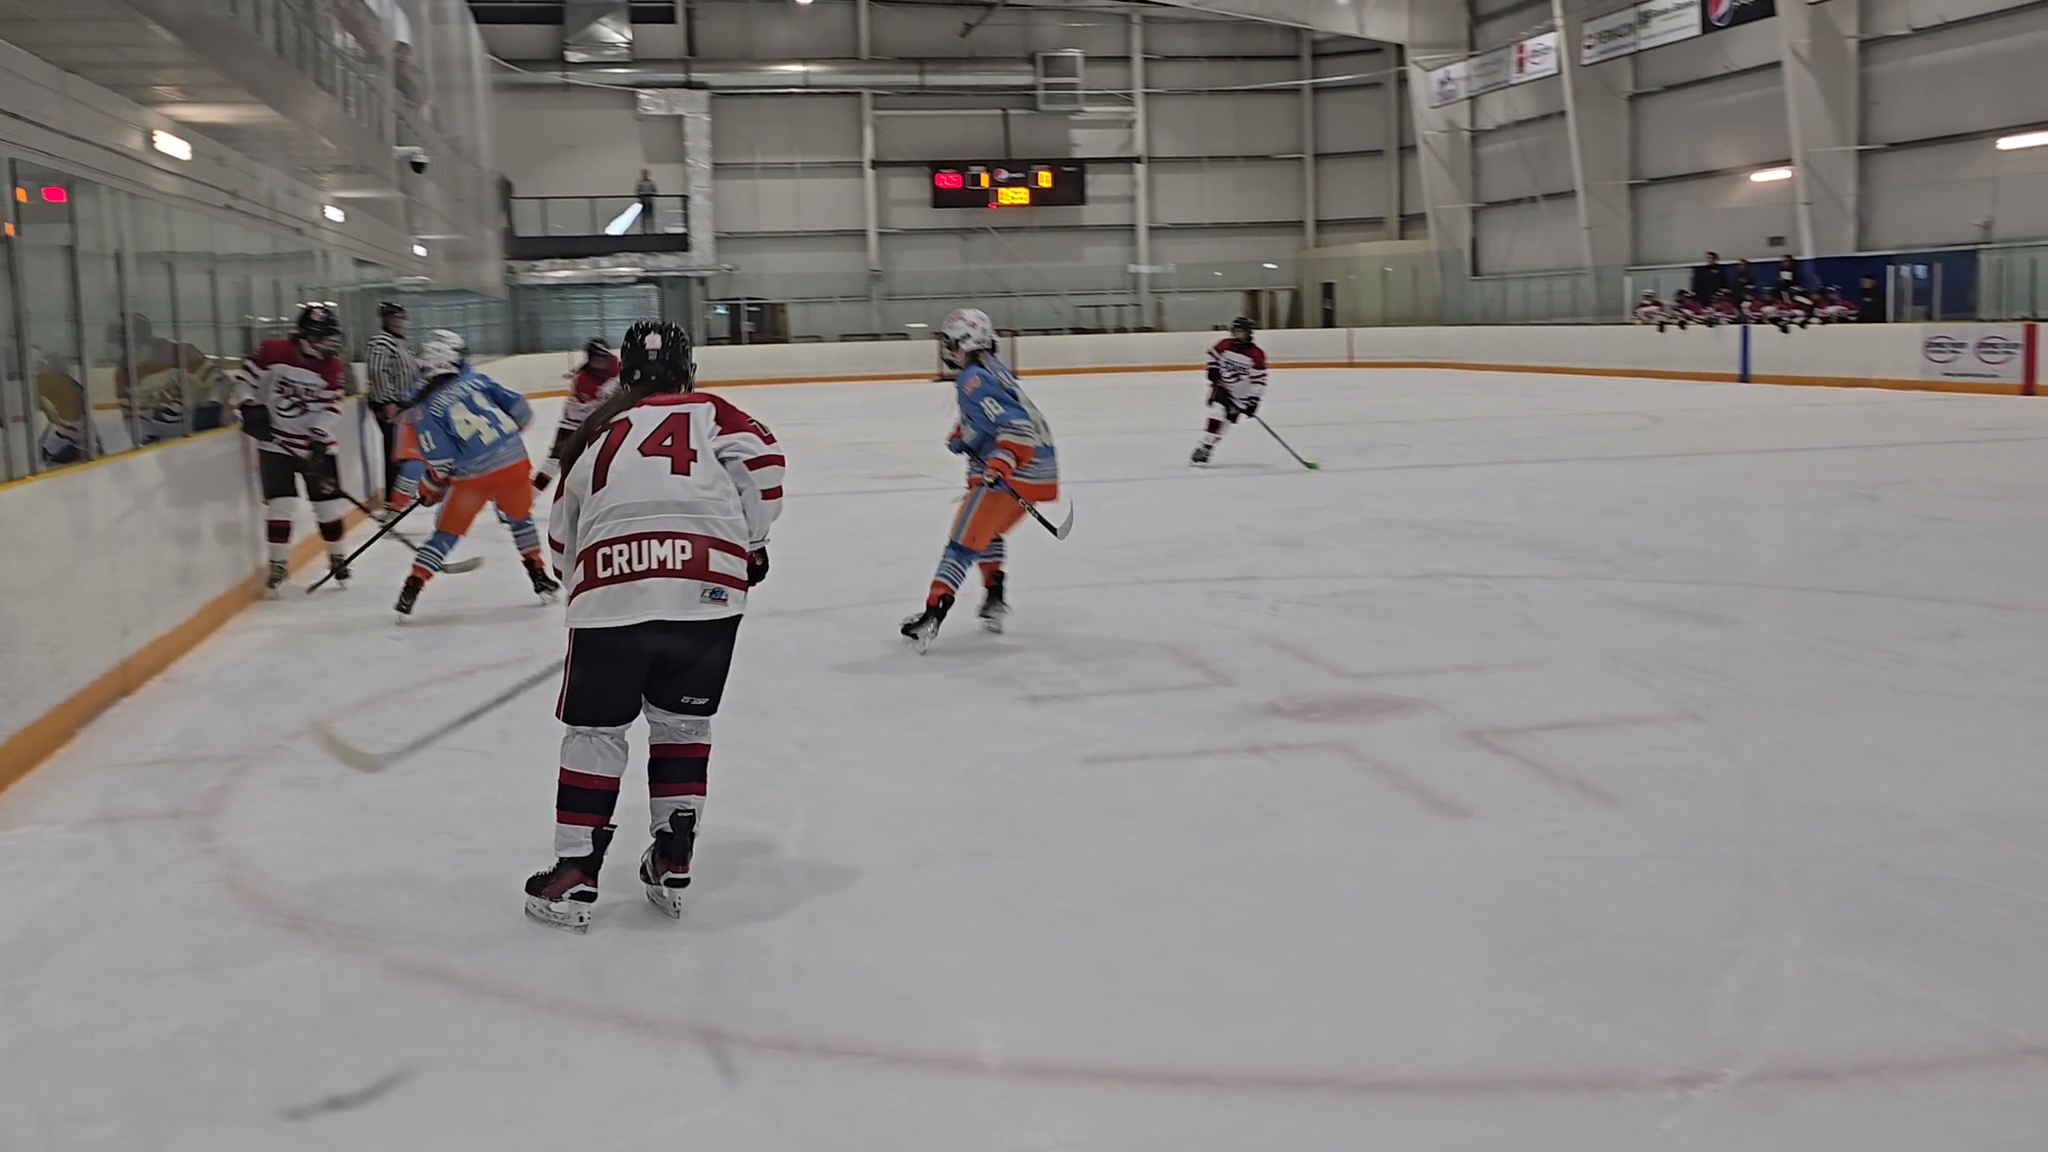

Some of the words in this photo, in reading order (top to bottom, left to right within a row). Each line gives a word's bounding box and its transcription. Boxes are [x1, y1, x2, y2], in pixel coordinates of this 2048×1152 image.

[449, 390, 520, 447] 41
[587, 411, 698, 495] 74
[595, 539, 693, 580] CRUMP
